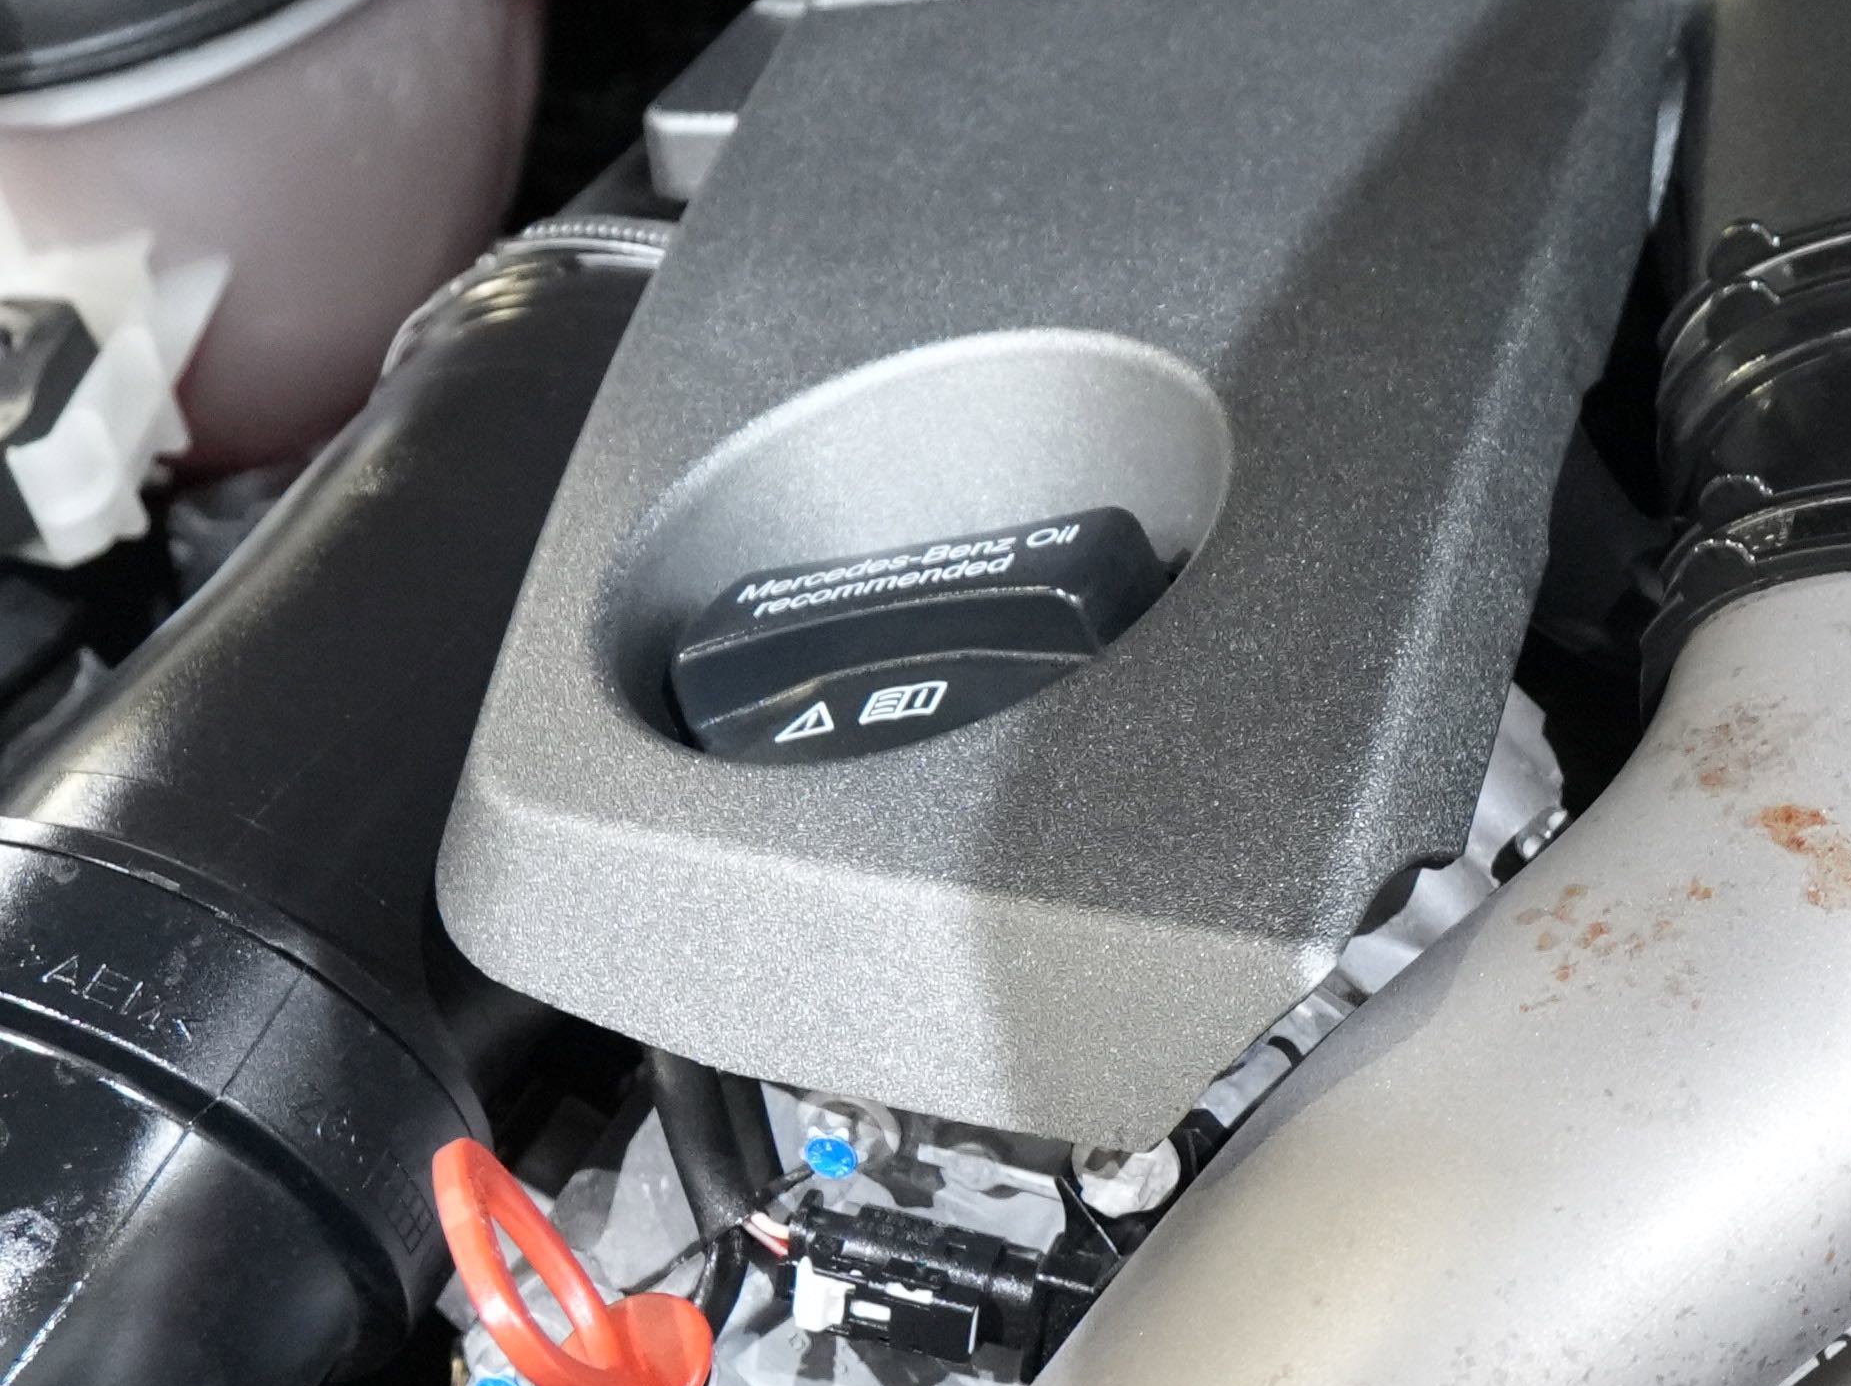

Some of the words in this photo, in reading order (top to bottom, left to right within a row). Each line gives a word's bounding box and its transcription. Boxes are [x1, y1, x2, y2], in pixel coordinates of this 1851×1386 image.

[737, 538, 1016, 604] Mercedes-Benz
[1026, 524, 1080, 549] Oil
[753, 553, 1016, 619] recommended
